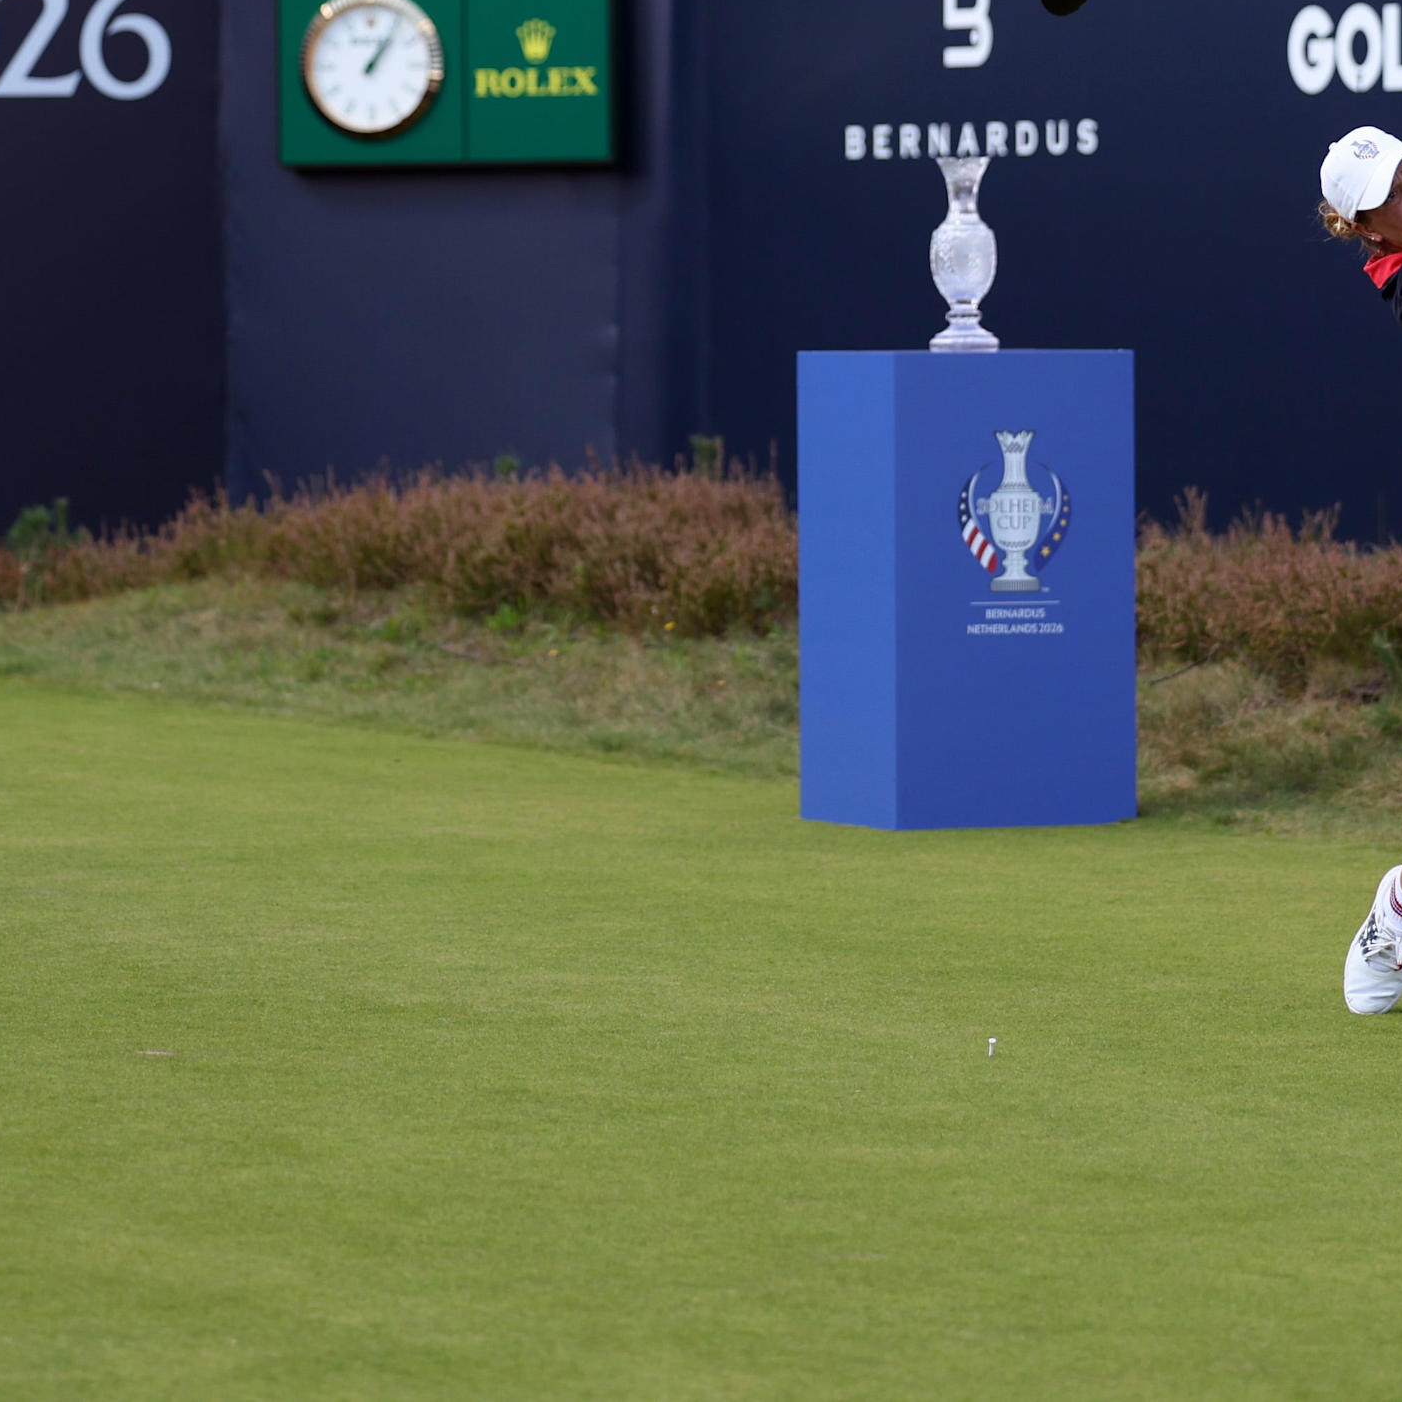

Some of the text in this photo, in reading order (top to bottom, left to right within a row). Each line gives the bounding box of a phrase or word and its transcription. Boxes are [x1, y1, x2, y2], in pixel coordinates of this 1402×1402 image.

[474, 66, 597, 98] ROLEX
[844, 118, 1099, 161] BERNARDUS
[976, 497, 1053, 515] SOLHEIM
[997, 515, 1032, 530] CUP
[985, 608, 1046, 620] BERNARDUS
[967, 622, 1064, 635] NETHERLANDS 2026
